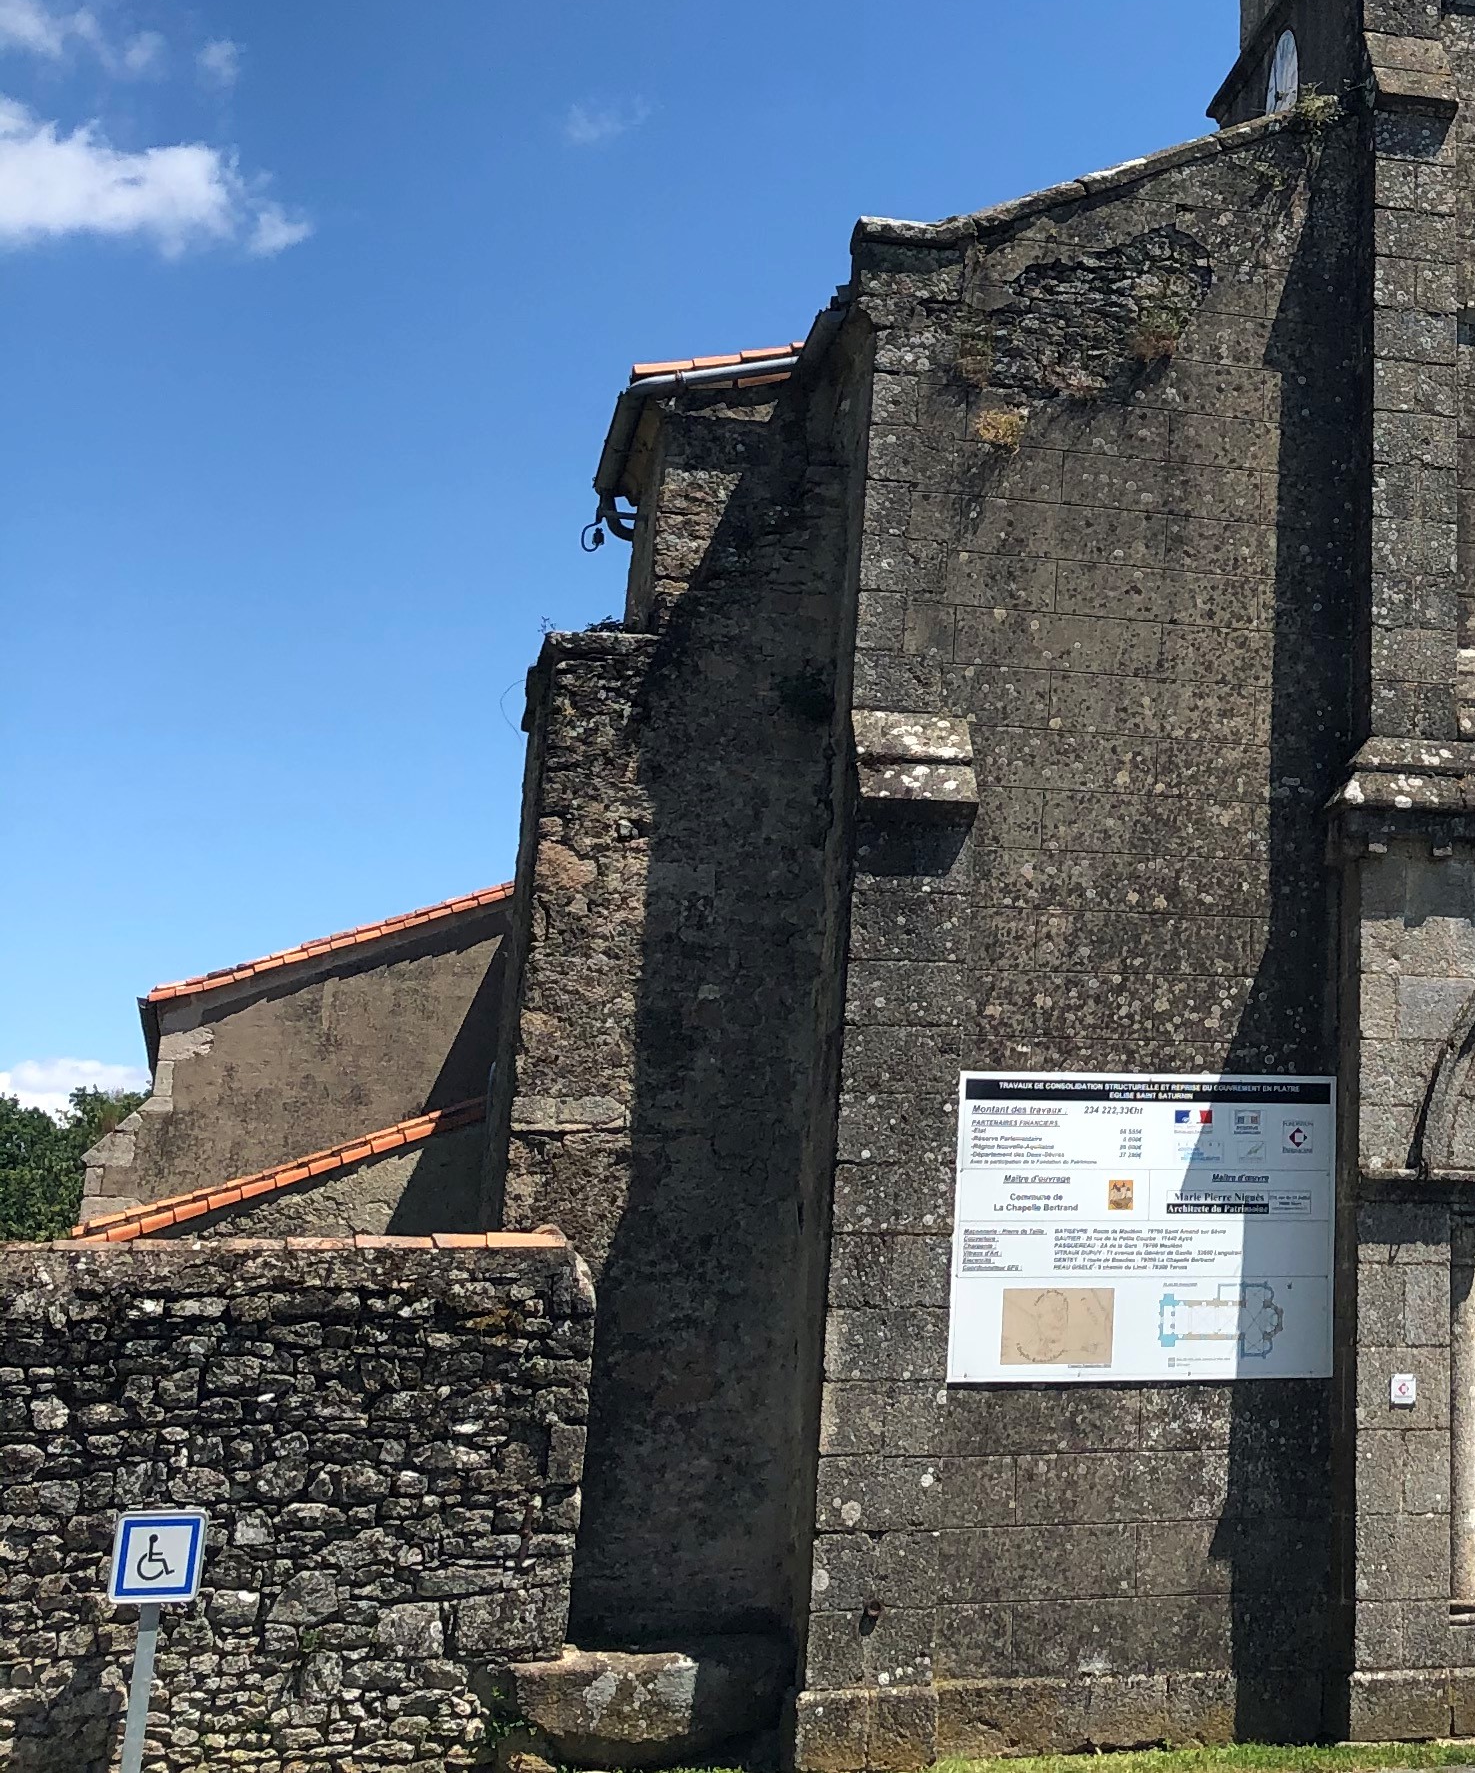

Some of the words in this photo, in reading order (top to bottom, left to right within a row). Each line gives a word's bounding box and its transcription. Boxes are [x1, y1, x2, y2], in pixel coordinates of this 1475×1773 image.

[998, 1082, 1033, 1090] TRAVAUX
[1045, 1082, 1103, 1090] CONSOLIDATION
[1104, 1083, 1159, 1091] STRUCTURELLE
[1202, 1084, 1212, 1092] DU
[972, 1105, 1009, 1114] Montant
[1011, 1105, 1026, 1114] des
[1030, 1105, 1062, 1114] travaux
[1084, 1105, 1099, 1114] 234
[971, 1119, 1018, 1127] PARTENAIRES
[1019, 1119, 1058, 1127] FINANCIERS
[1003, 1175, 1029, 1183] Maître
[1031, 1175, 1070, 1184] d'ouvrage
[1212, 1173, 1236, 1182] Maître
[1009, 1193, 1051, 1201] Commune
[1053, 1193, 1063, 1201] de
[1174, 1192, 1202, 1201] Marie
[1204, 1192, 1232, 1201] Pierre
[1006, 1204, 1041, 1213] Chapelle
[1167, 1205, 1210, 1213] Architecte
[1211, 1205, 1222, 1213] du
[1224, 1205, 1268, 1213] Patrimoine
